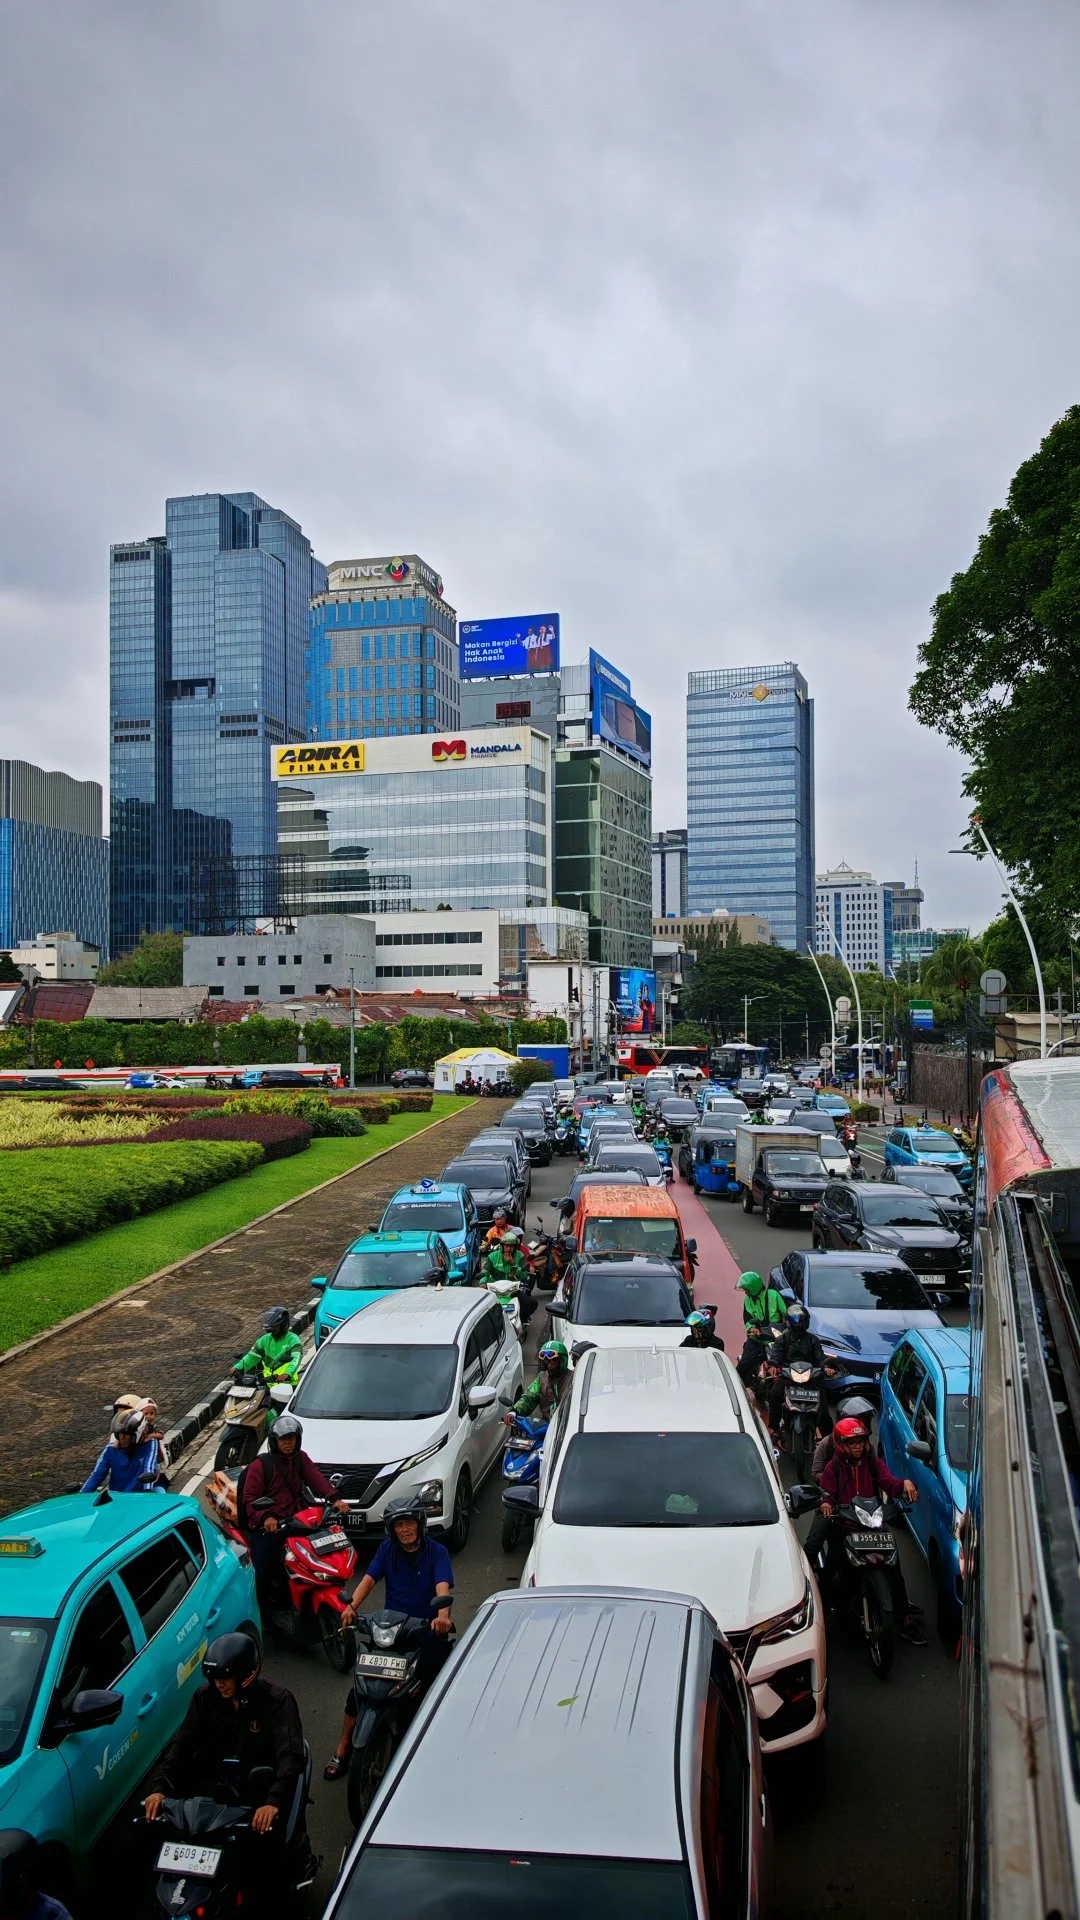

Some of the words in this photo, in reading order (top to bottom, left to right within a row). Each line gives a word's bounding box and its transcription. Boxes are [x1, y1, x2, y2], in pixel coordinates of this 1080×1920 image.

[341, 565, 383, 578] MNC
[492, 639, 518, 648] Bergizi
[482, 647, 504, 655] Anak
[465, 654, 505, 663] Indonesia
[730, 690, 754, 699] MNC
[279, 745, 360, 763] ADIRA
[470, 744, 521, 754] MANDALA
[289, 761, 360, 773] FINANCE
[347, 1514, 363, 1525] TRF
[361, 1656, 366, 1664] B
[369, 1656, 388, 1666] 4830
[163, 1845, 171, 1856] B
[173, 1847, 197, 1861] 6609
[200, 1850, 219, 1862] PTT
